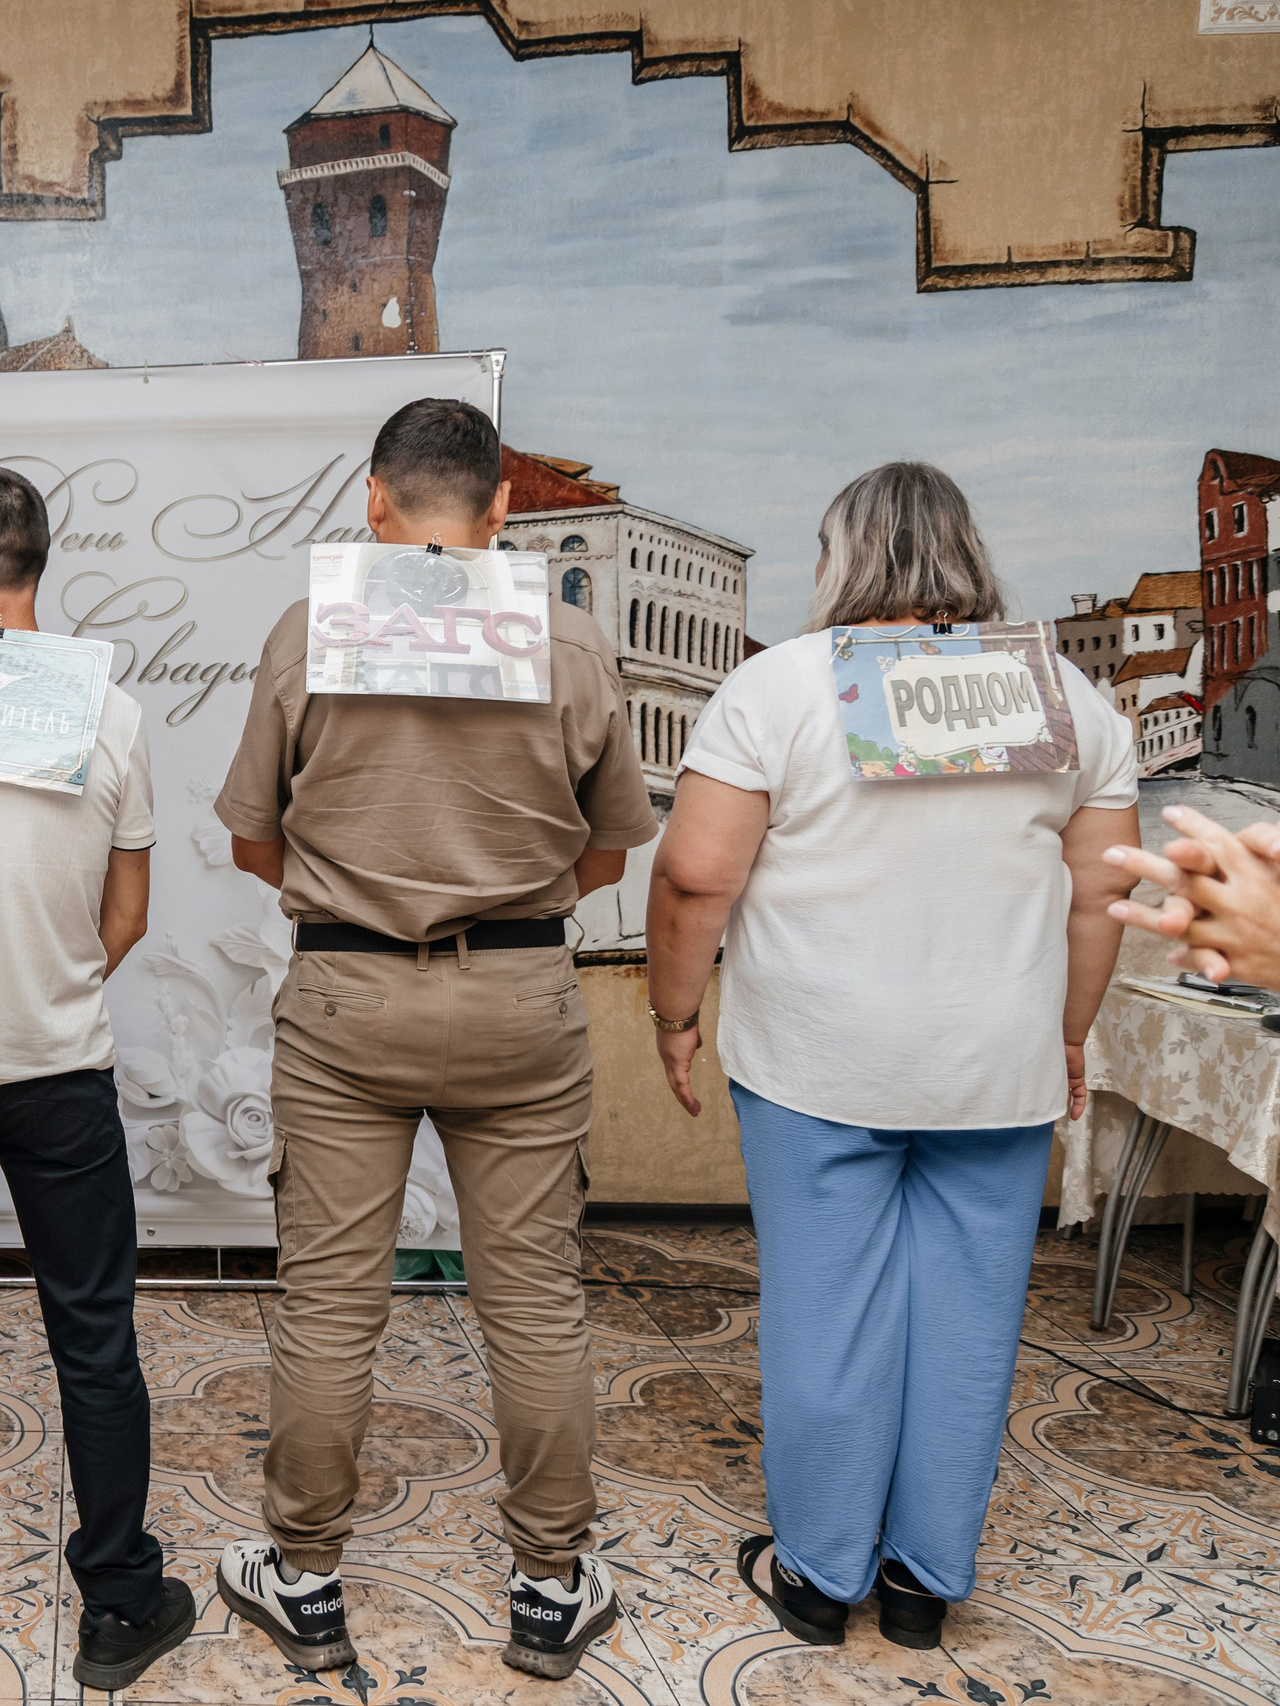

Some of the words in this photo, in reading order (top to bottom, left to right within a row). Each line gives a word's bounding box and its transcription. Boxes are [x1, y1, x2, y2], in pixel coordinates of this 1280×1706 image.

[311, 602, 546, 658] ЗАГС
[890, 671, 1039, 731] РОДДОМ
[300, 1597, 344, 1615] adida
[511, 1599, 563, 1622] adidas
